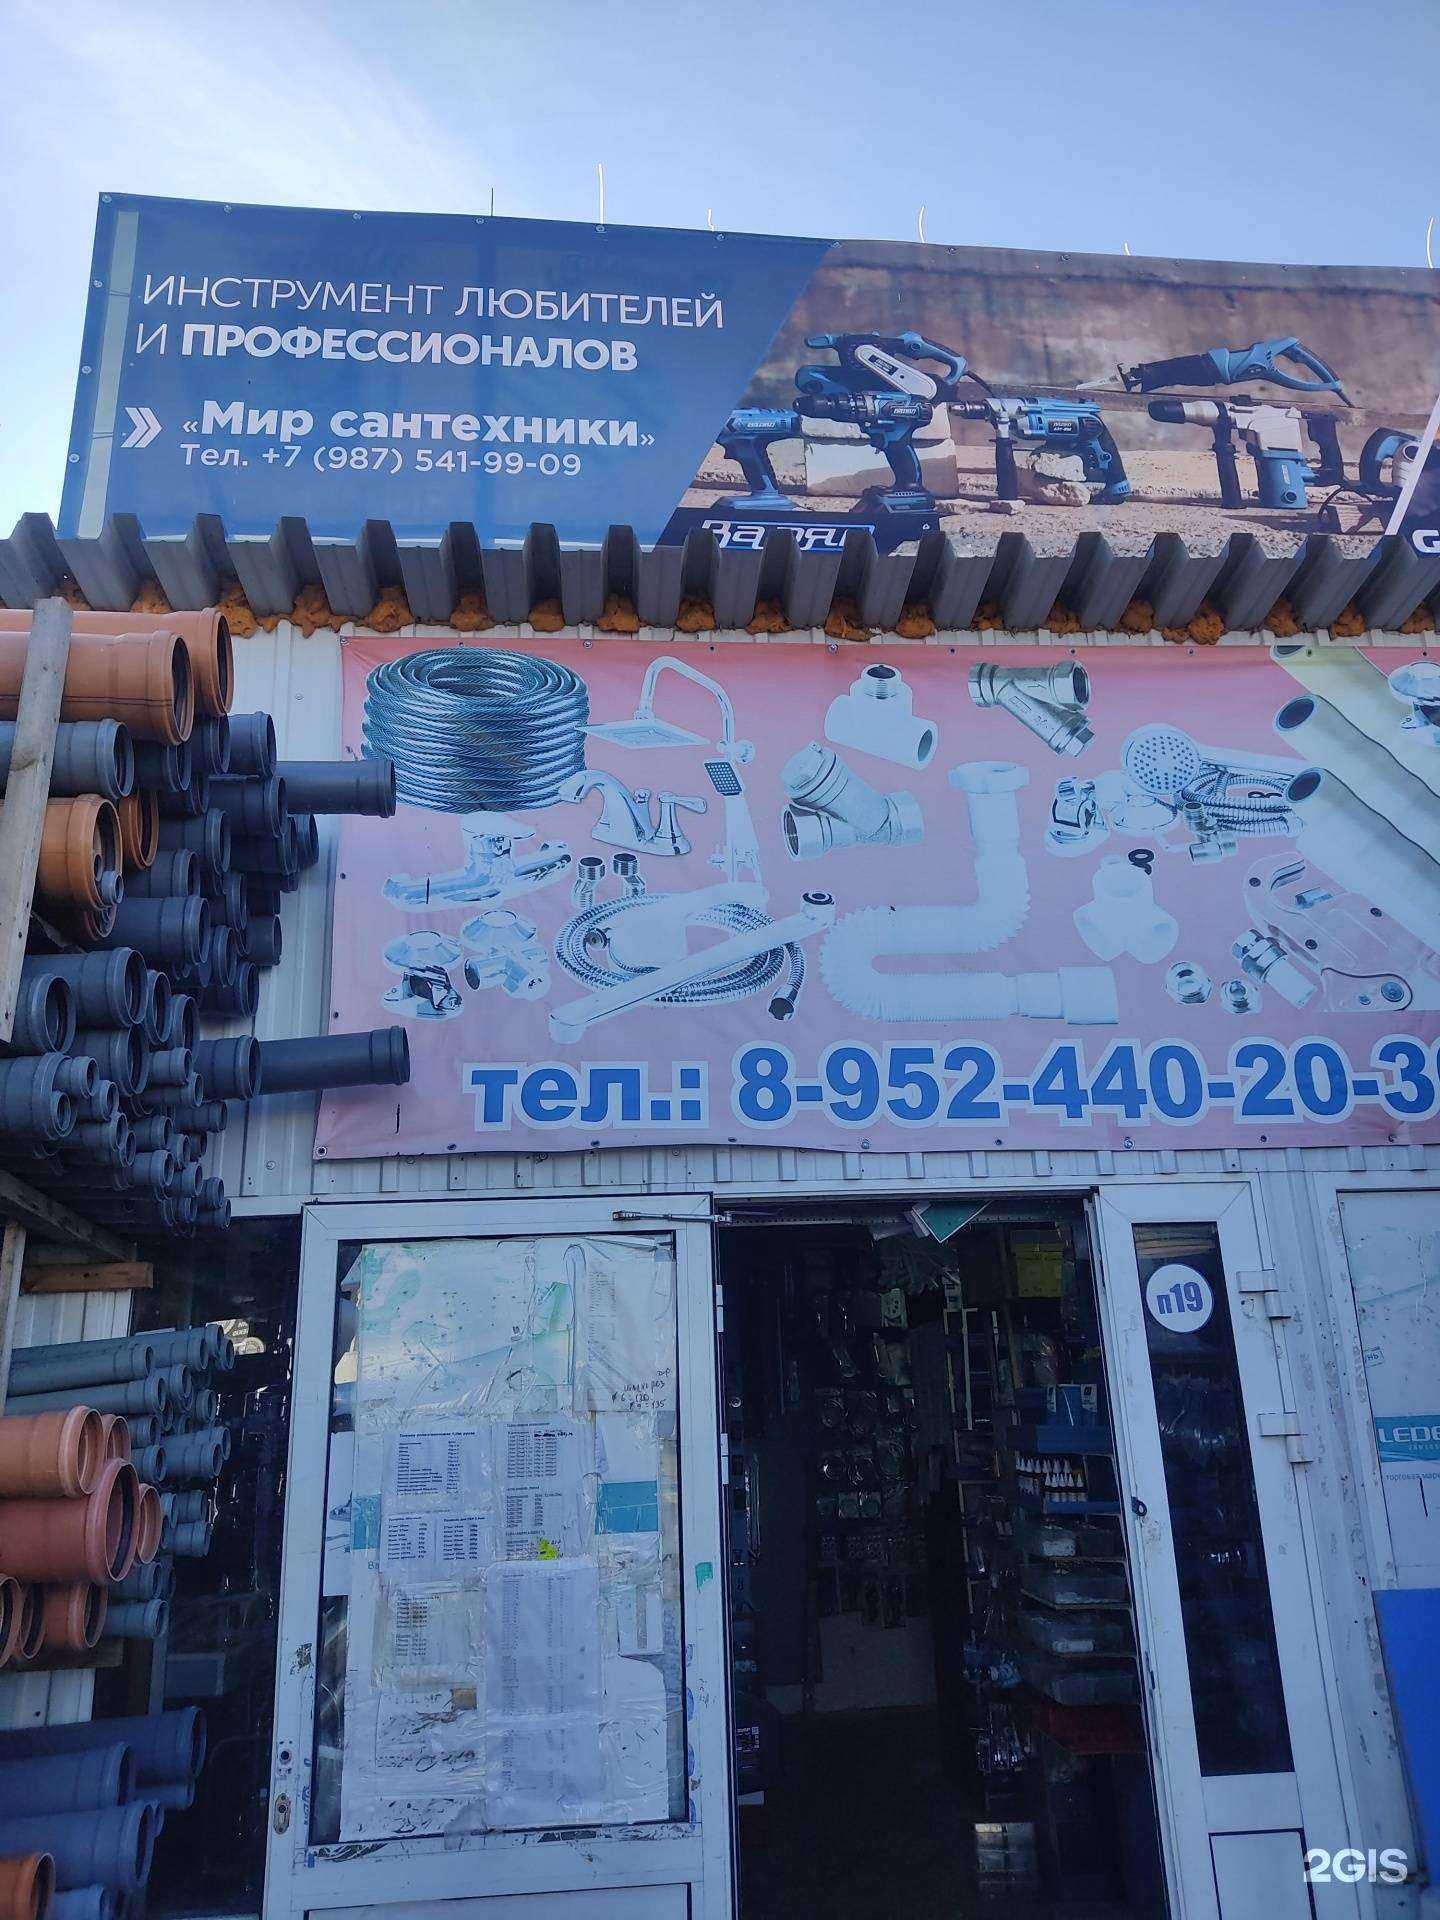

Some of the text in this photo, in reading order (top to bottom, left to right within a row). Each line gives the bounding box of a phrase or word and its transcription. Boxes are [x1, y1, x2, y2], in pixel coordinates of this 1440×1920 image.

[143, 274, 724, 329] ИНСТРУМЕНТ ЛЮБИТЕЛЕЙ
[136, 323, 639, 372] И ПРОФЕССИОНАЛОВ
[182, 400, 656, 447] «Мир сантехники»
[180, 443, 581, 476] Тел. +7 (987) 541-99-09
[468, 1038, 1440, 1126] тел.: 8-952-440-20-3
[1157, 1282, 1203, 1314] п19
